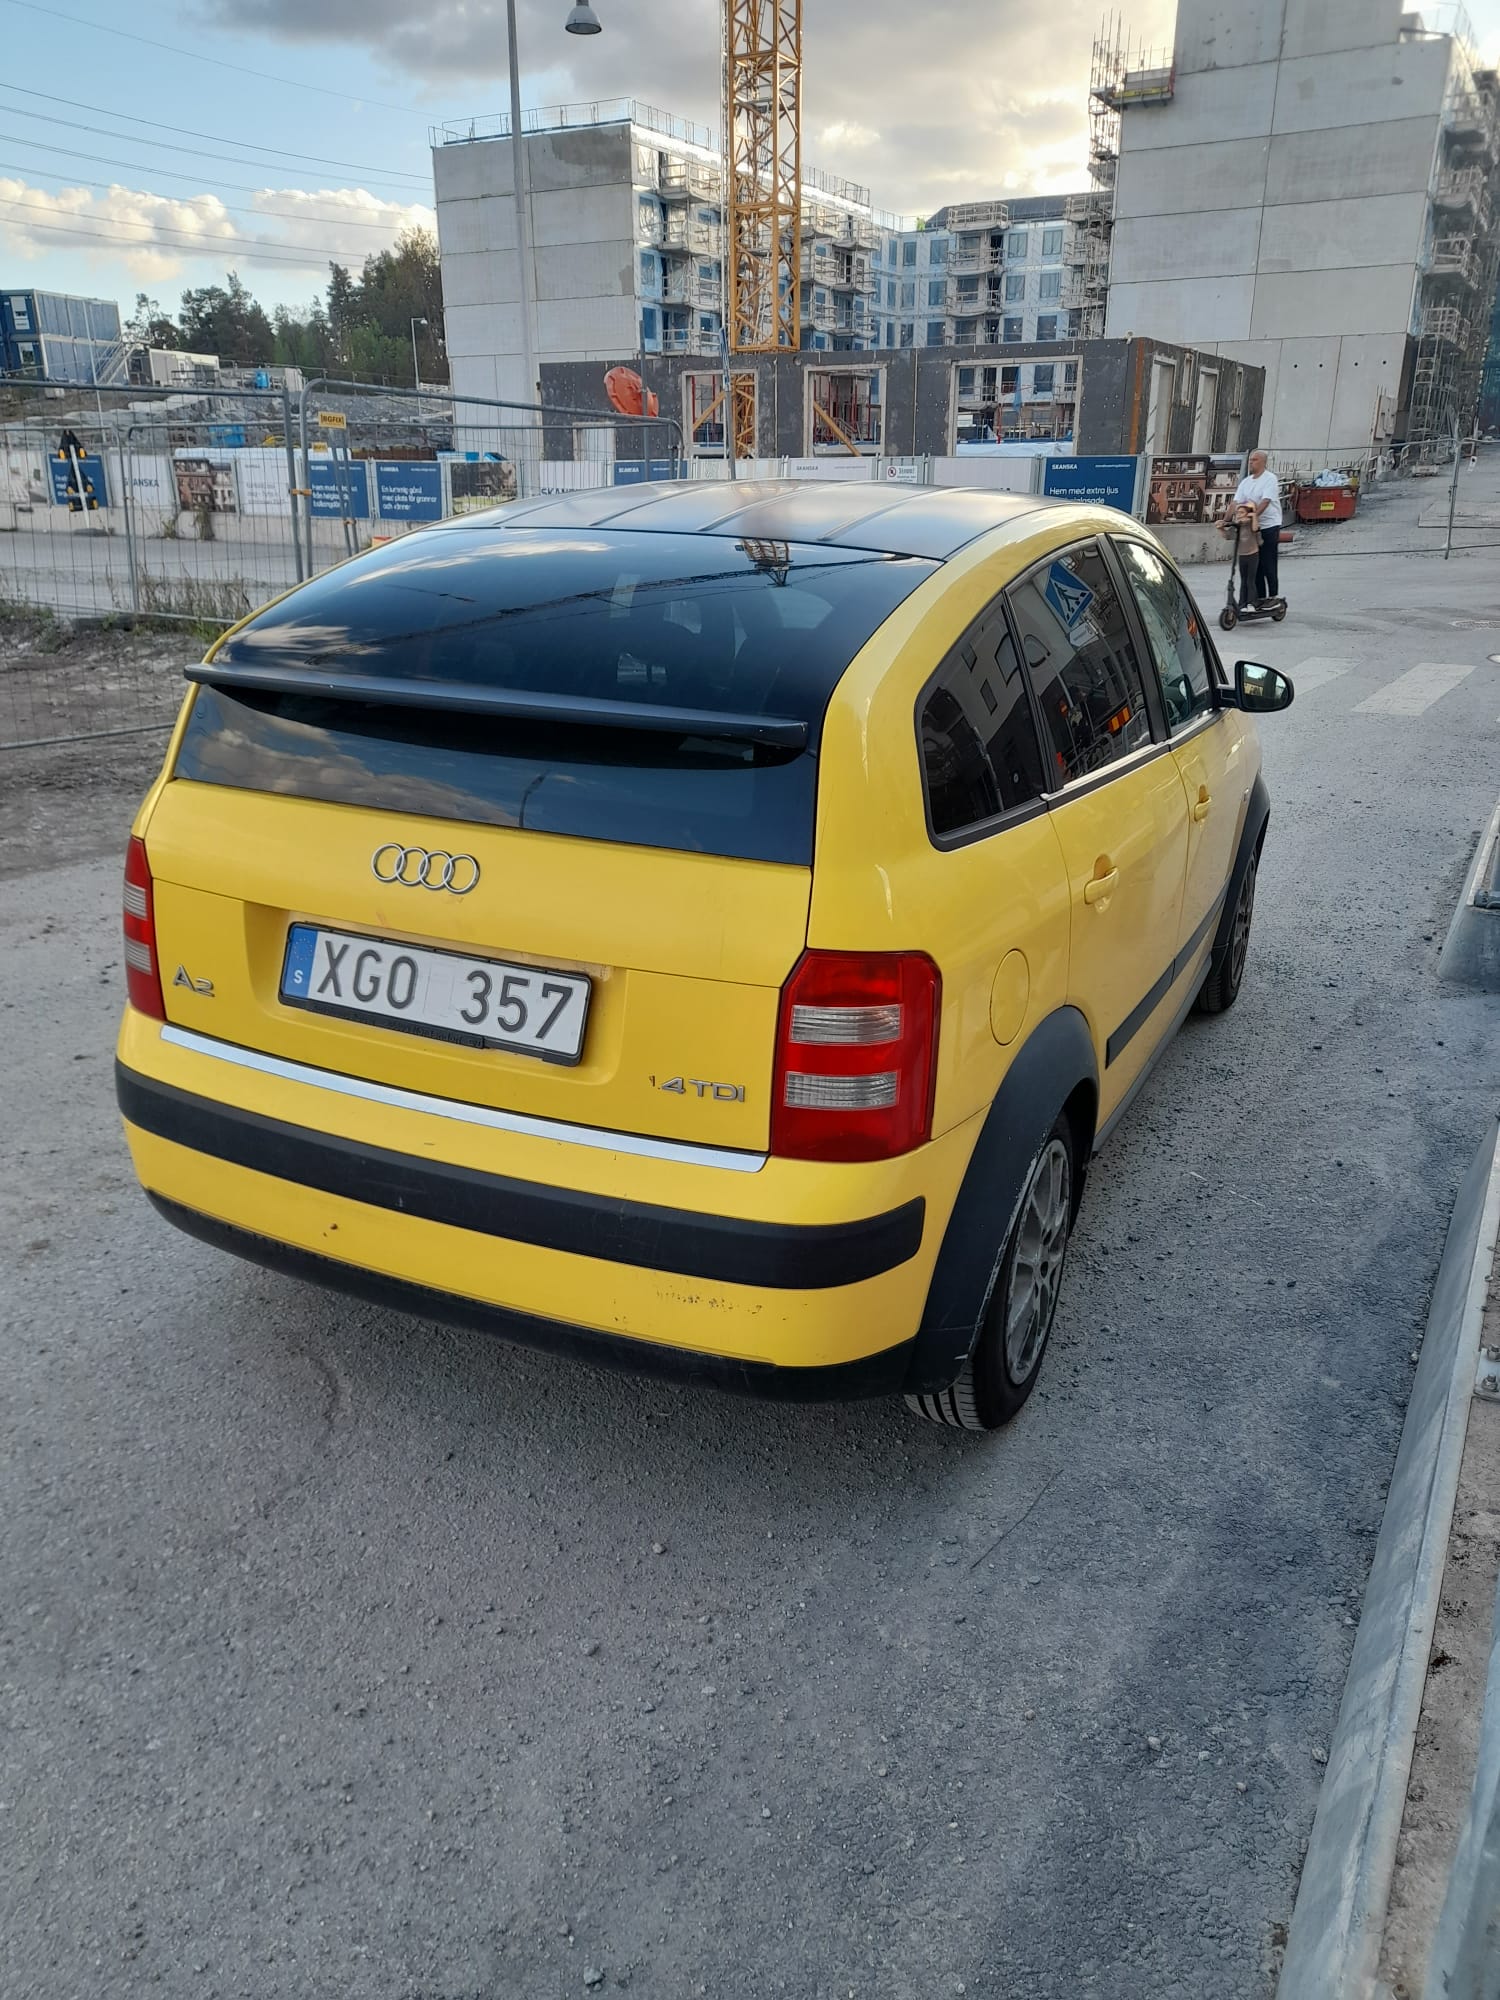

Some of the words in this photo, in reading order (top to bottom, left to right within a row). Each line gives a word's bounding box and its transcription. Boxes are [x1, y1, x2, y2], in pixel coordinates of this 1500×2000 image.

[1049, 487, 1067, 495] Hem
[1068, 485, 1086, 495] med
[1086, 486, 1106, 495] extra
[1106, 485, 1119, 496] ljus
[173, 964, 215, 998] A2
[292, 969, 304, 984] S
[317, 940, 419, 1010] XGO
[460, 970, 574, 1039] 357
